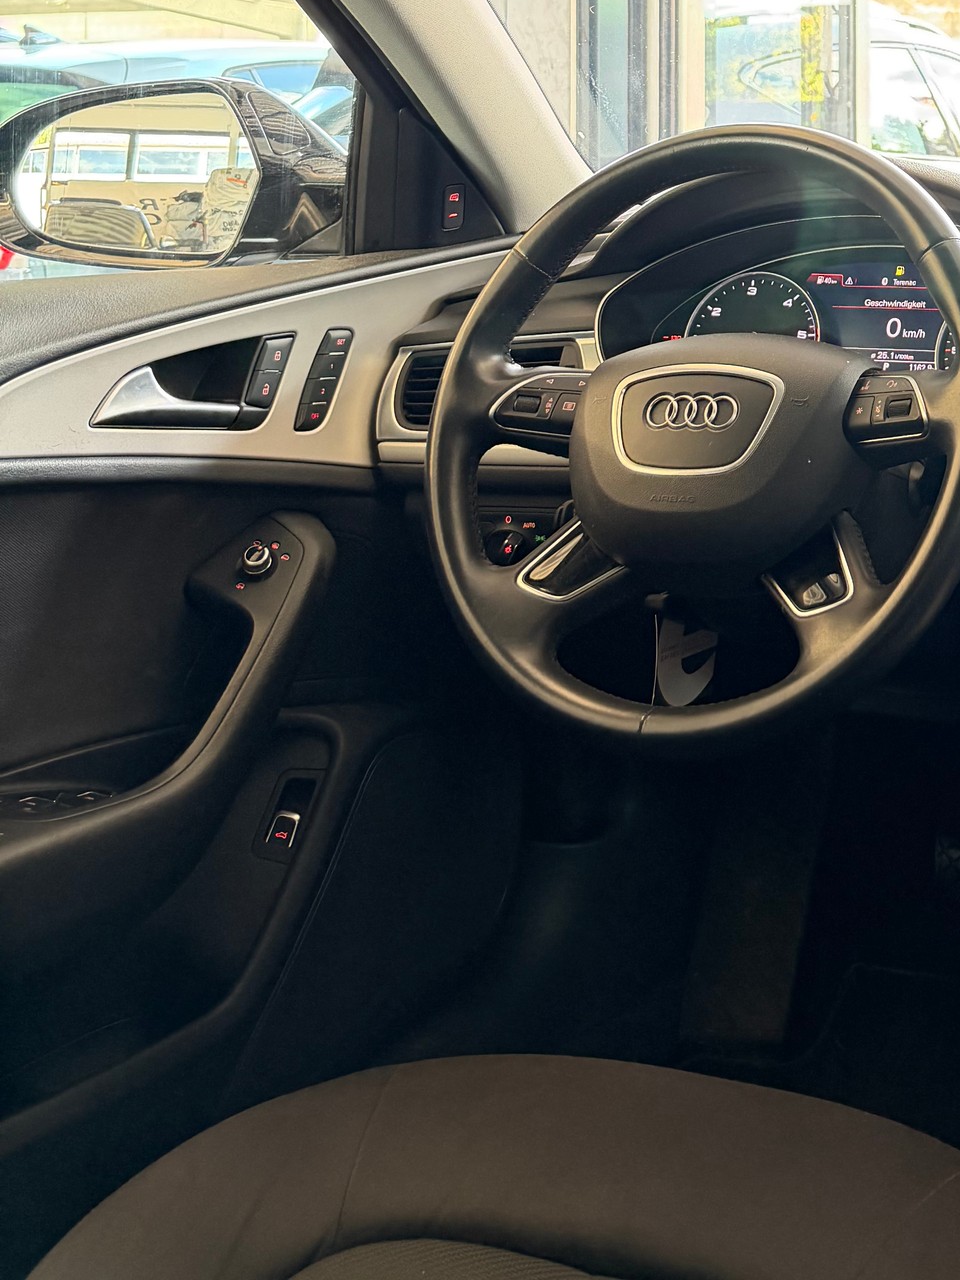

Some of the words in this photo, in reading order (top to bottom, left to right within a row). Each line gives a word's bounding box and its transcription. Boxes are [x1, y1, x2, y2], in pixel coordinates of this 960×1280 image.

[746, 286, 758, 296] 3
[782, 298, 793, 308] 4
[864, 298, 926, 309] Geschwindigkeit
[711, 307, 722, 317] 2
[886, 317, 902, 338] 0
[902, 328, 926, 339] km/h
[796, 330, 808, 339] 5
[882, 362, 890, 371] P
[649, 494, 696, 504] AIRBAG
